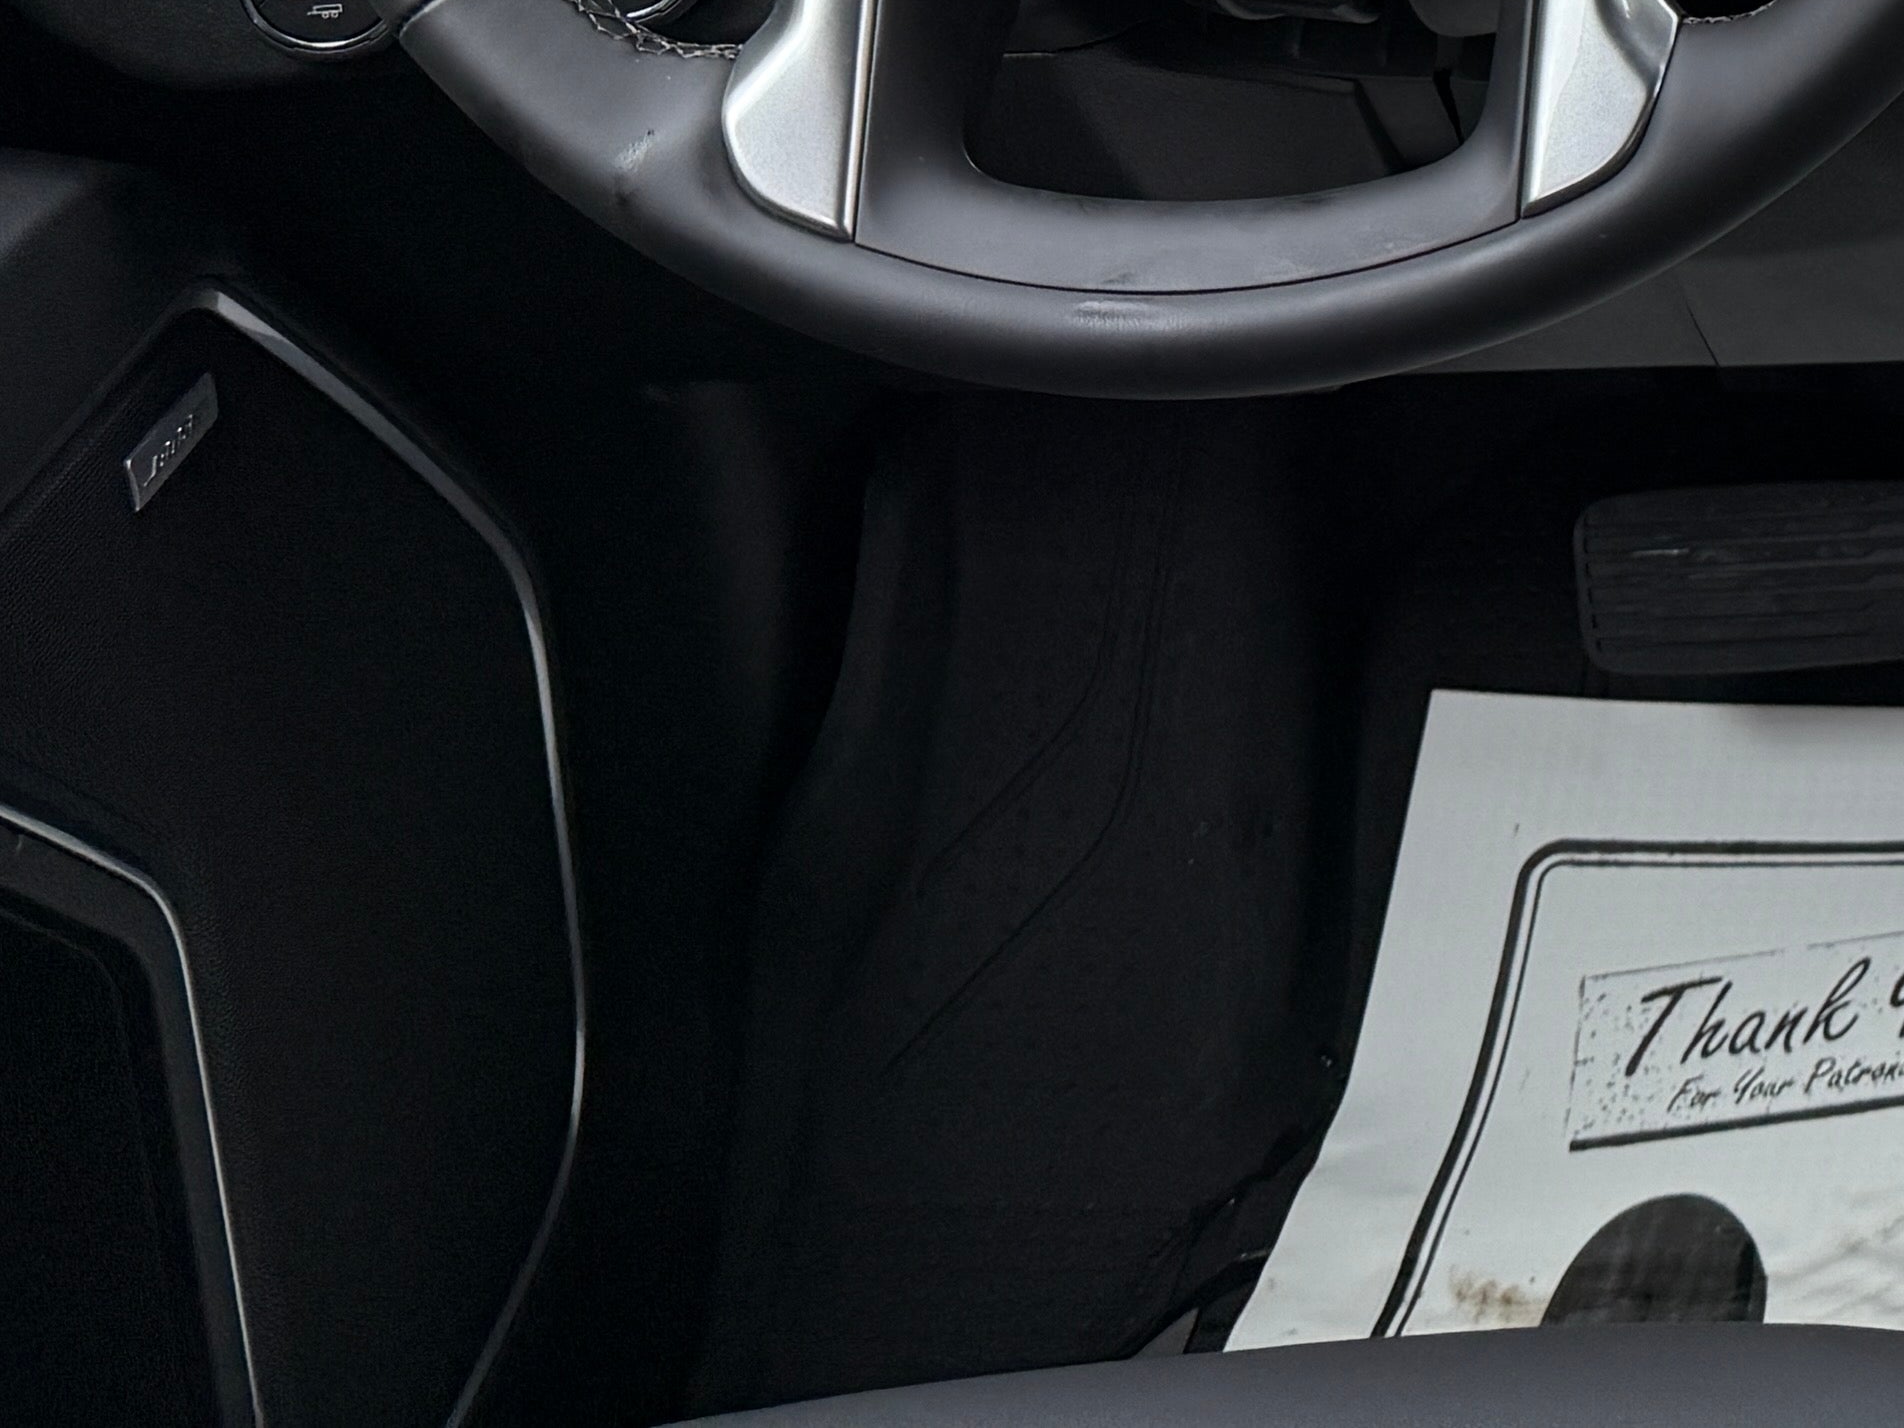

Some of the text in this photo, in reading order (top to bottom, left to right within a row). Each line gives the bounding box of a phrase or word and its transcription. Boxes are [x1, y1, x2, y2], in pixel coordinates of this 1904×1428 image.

[1624, 955, 1872, 1078] Thank
[1667, 1075, 1720, 1113] For
[1733, 1067, 1797, 1106] Your
